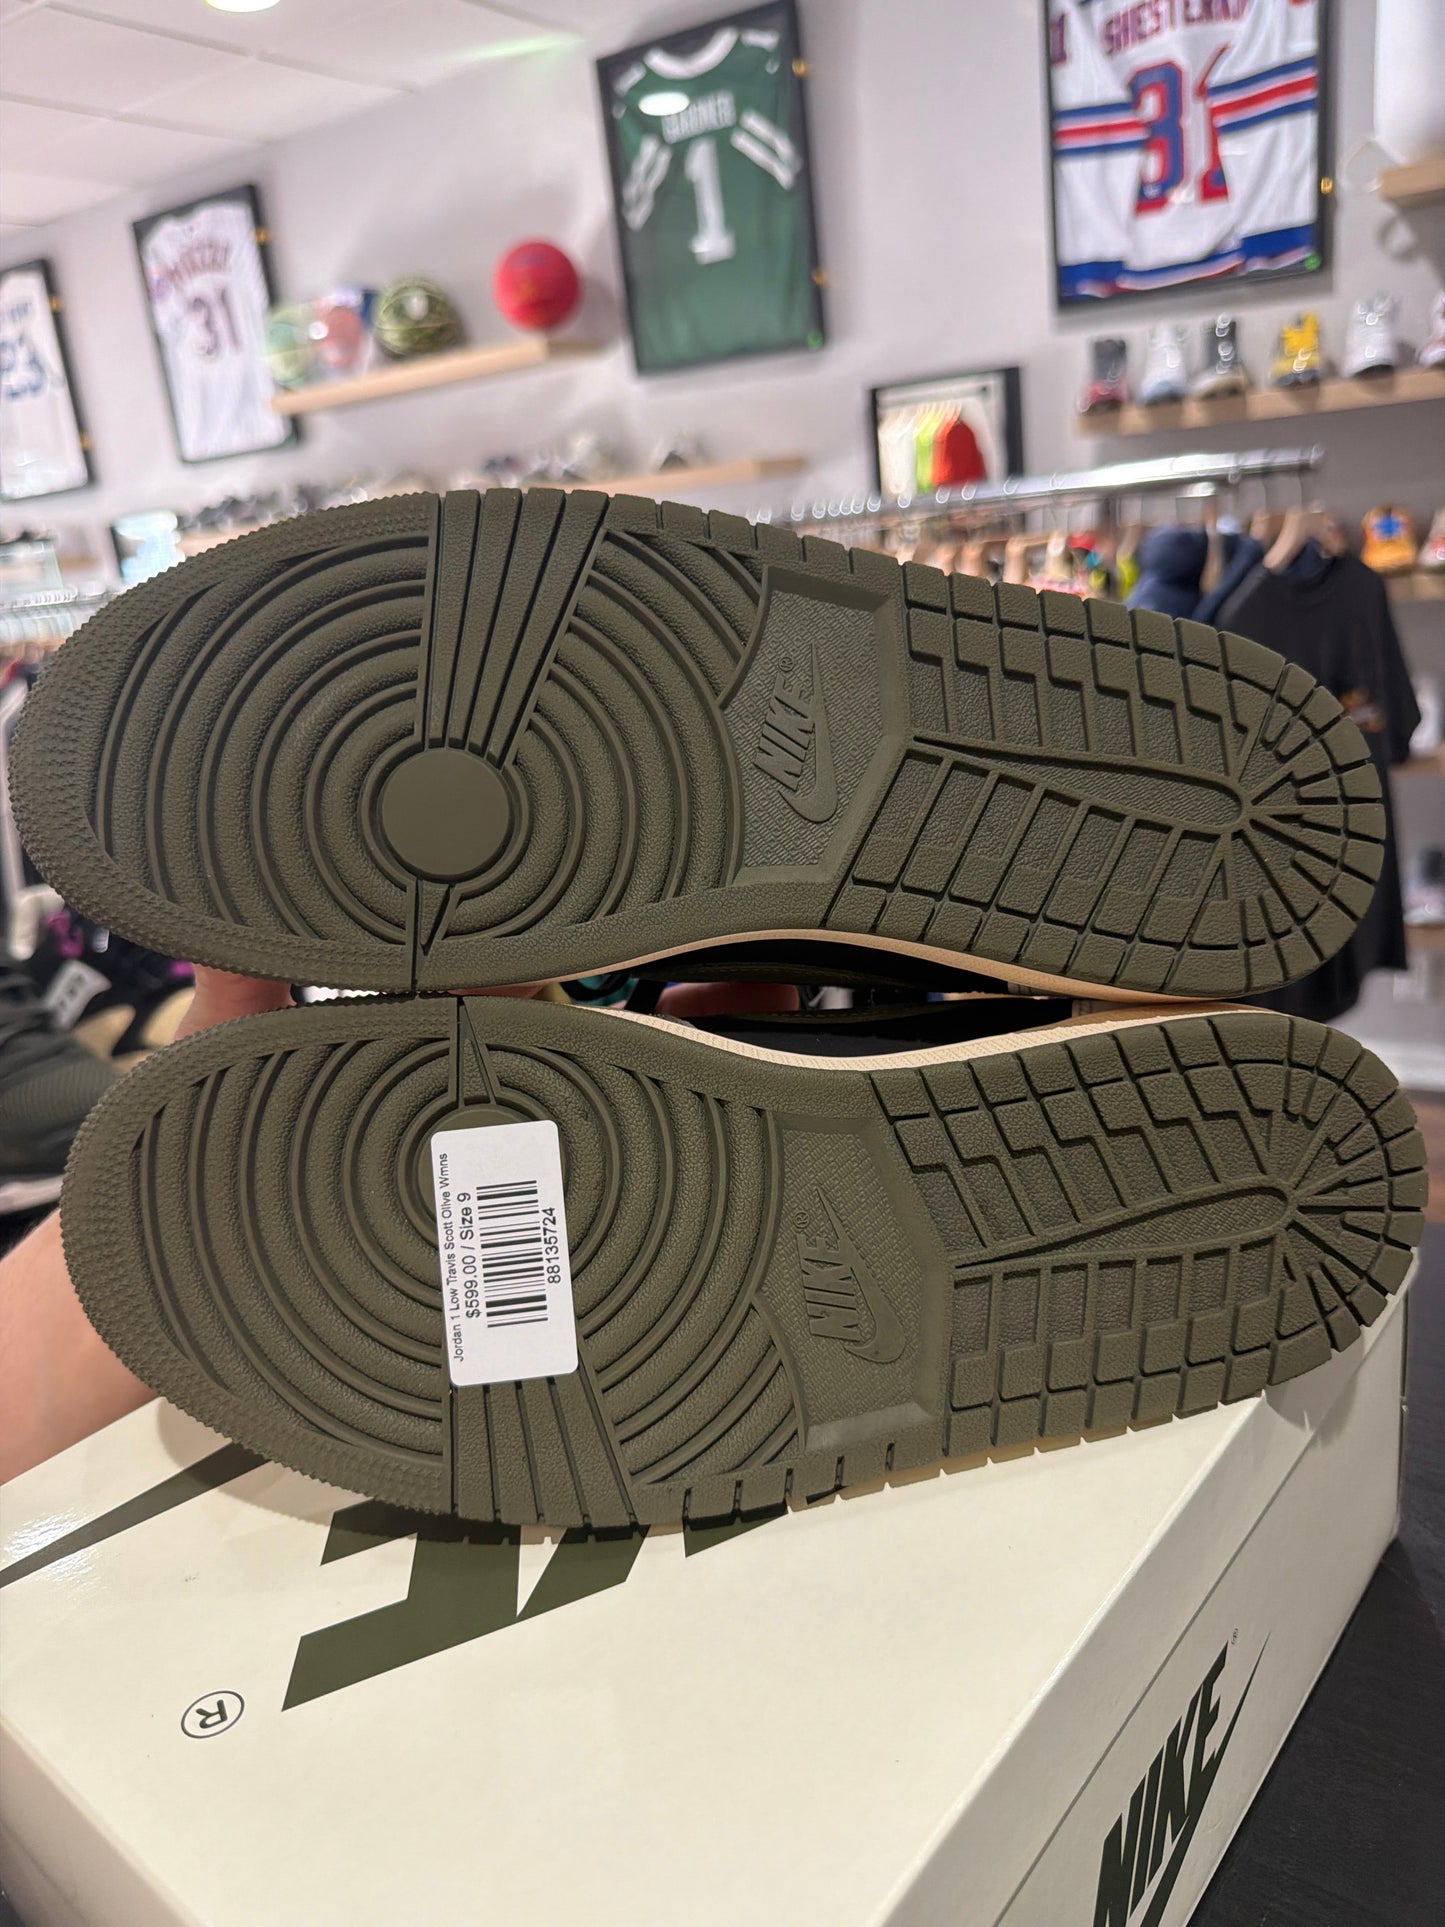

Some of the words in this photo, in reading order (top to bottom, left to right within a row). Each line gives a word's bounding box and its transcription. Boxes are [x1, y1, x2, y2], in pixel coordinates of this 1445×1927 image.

[685, 136, 736, 265] 1
[753, 671, 816, 793] NIKE
[439, 1153, 450, 1190] Wmns
[441, 1191, 452, 1219] Olive
[456, 1192, 471, 1203] 9
[443, 1221, 455, 1251] Scott
[459, 1206, 474, 1240] Size
[542, 1207, 562, 1285] 88135724
[445, 1253, 458, 1286] Travis
[462, 1255, 482, 1319] $599.00
[796, 1233, 861, 1343] NIKE
[449, 1287, 460, 1311] Low
[452, 1323, 464, 1362] Jordan
[1093, 1640, 1229, 1927] NIKE
